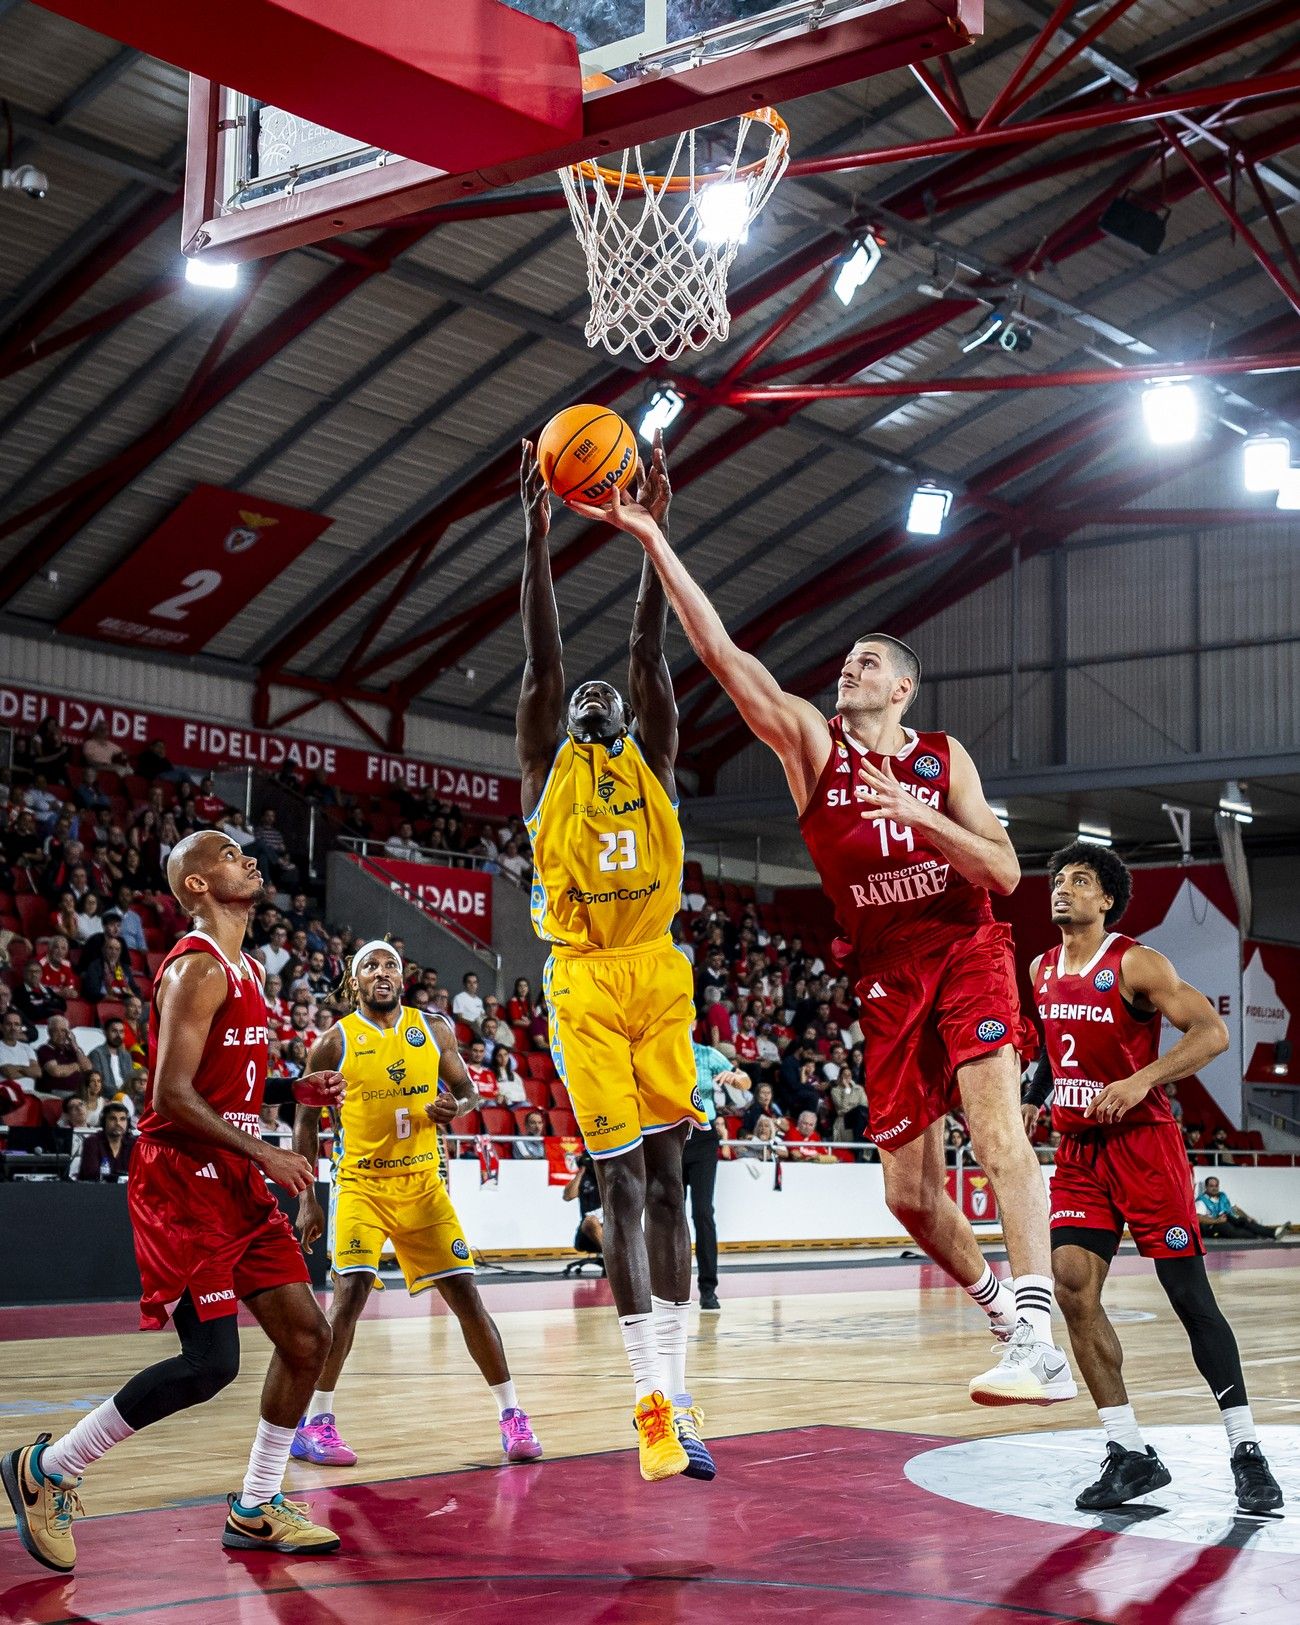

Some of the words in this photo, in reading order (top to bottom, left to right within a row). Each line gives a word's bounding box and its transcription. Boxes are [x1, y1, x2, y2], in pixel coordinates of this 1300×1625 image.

[573, 438, 594, 460] FIBA
[148, 568, 222, 620] 2
[183, 723, 336, 773] FIDELIDADE
[366, 755, 500, 801] FIDELIDADE
[826, 787, 852, 807] SL
[598, 829, 638, 872] 23
[872, 816, 916, 857] 14
[867, 860, 938, 882] conservas
[1050, 1004, 1115, 1023] BENFICA
[223, 1028, 241, 1046] SL
[1061, 1033, 1079, 1067] 2
[244, 1060, 257, 1101] 9
[361, 1084, 430, 1101] DREAMLAND
[394, 1107, 412, 1140] 6
